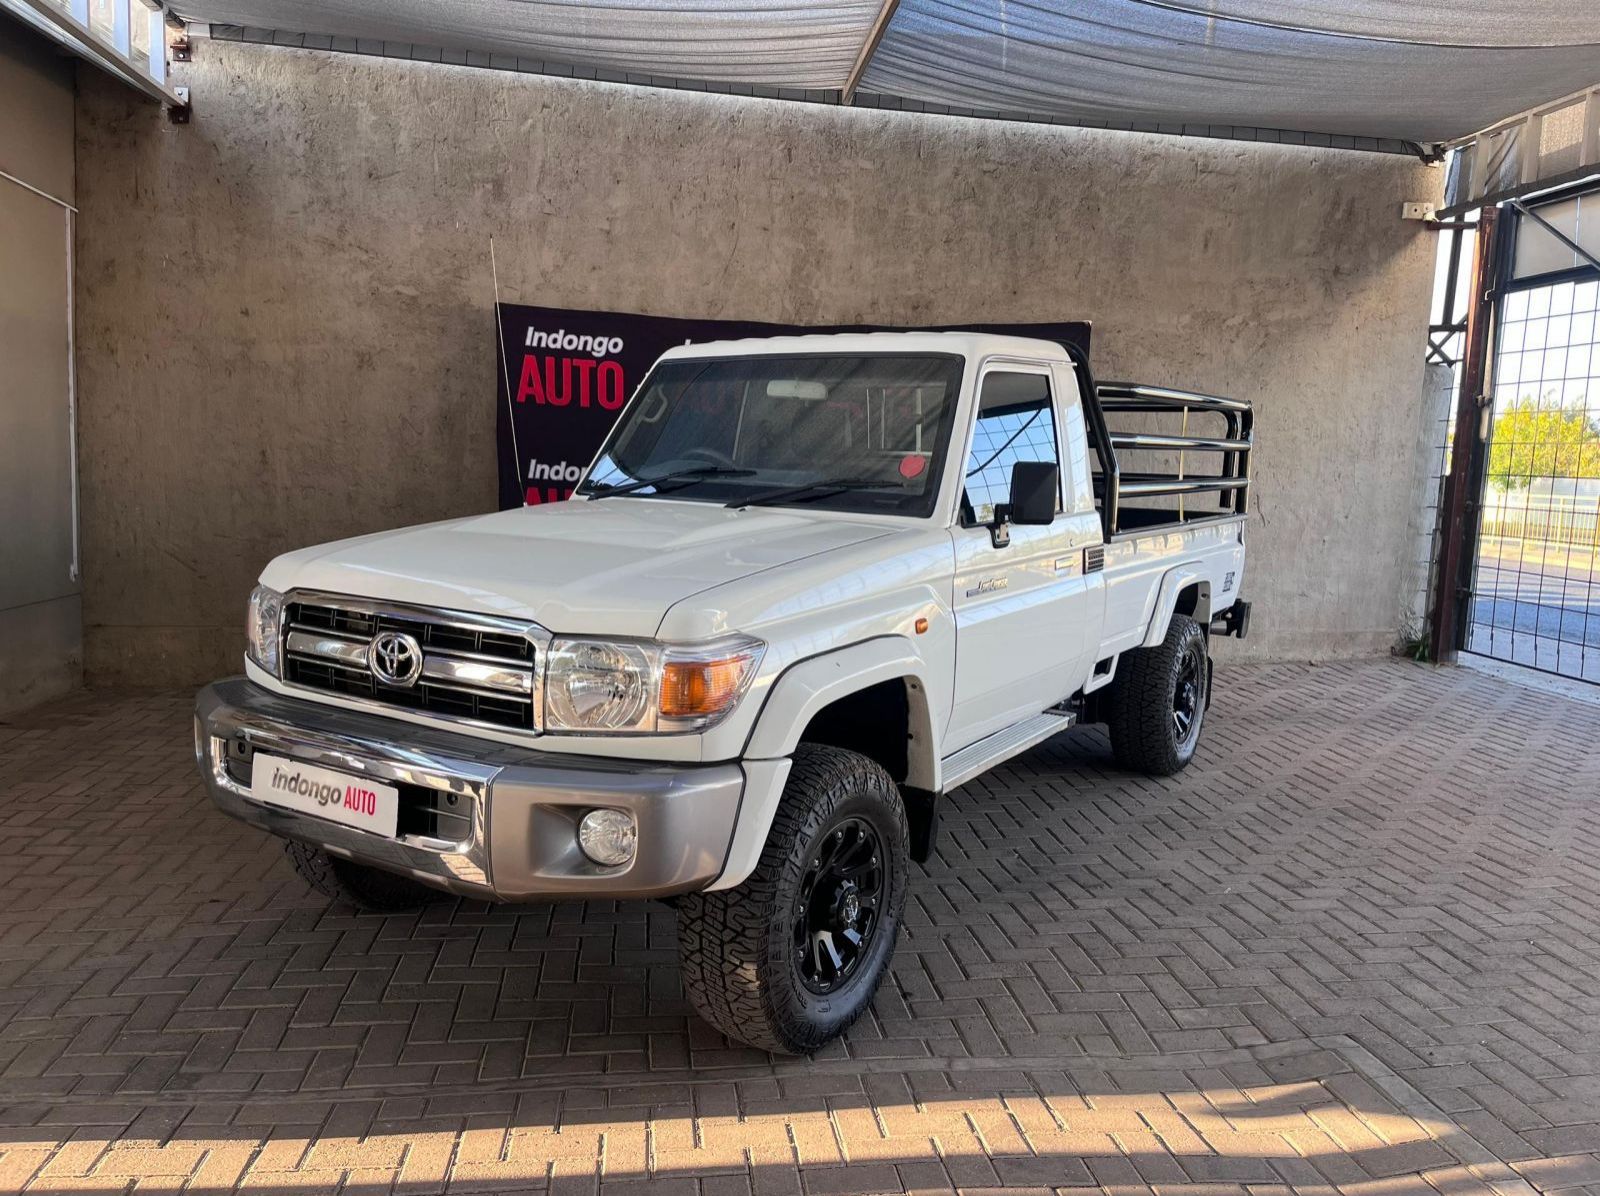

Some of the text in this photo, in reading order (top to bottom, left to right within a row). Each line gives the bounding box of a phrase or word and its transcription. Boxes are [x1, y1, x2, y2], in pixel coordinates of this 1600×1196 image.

[525, 326, 624, 357] Indongo
[516, 354, 624, 410] AUTO
[528, 459, 588, 481] Indo
[343, 785, 376, 816] AUTO
